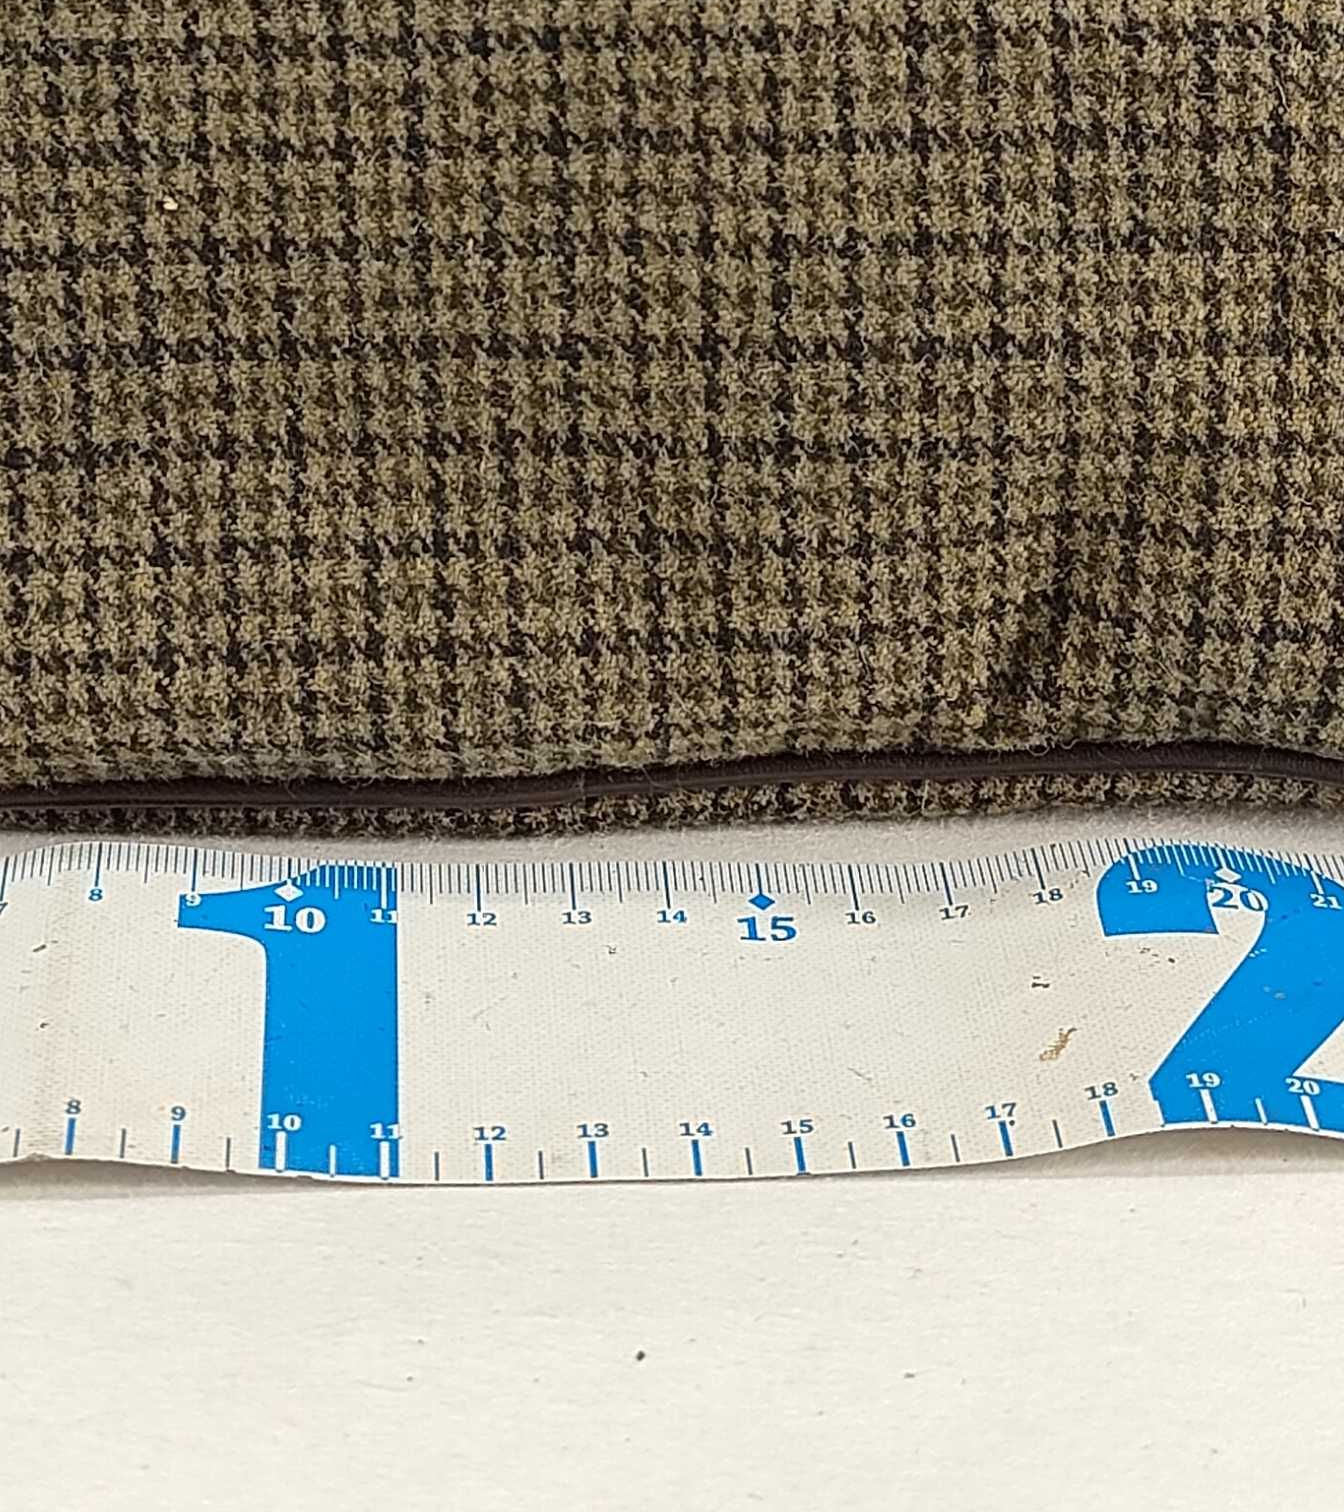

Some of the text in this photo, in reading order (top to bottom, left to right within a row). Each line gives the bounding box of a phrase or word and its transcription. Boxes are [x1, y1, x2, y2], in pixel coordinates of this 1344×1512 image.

[88, 888, 103, 901] 8
[185, 893, 201, 907] 9
[263, 905, 326, 933] 10
[371, 909, 397, 924] 11
[467, 913, 497, 926] 12
[562, 911, 592, 924] 13
[657, 910, 687, 923] 14
[737, 916, 797, 942] 15
[846, 912, 877, 924] 16
[940, 905, 969, 920] 17
[1033, 889, 1064, 904] 18
[1126, 880, 1158, 894] 19
[1210, 885, 1270, 913] 20
[1311, 893, 1343, 910] 21
[177, 862, 398, 1178] 1
[65, 1098, 81, 1115] 8
[171, 1106, 186, 1121] 9
[267, 1114, 302, 1131] 10
[369, 1123, 403, 1138] 11
[473, 1126, 507, 1141] 12
[577, 1123, 610, 1138] 13
[679, 1122, 714, 1137] 14
[781, 1120, 814, 1135] 15
[883, 1113, 916, 1129] 16
[985, 1103, 1016, 1119] 17
[1085, 1082, 1119, 1100] 18
[1186, 1072, 1221, 1088] 19
[1285, 1078, 1320, 1096] 20
